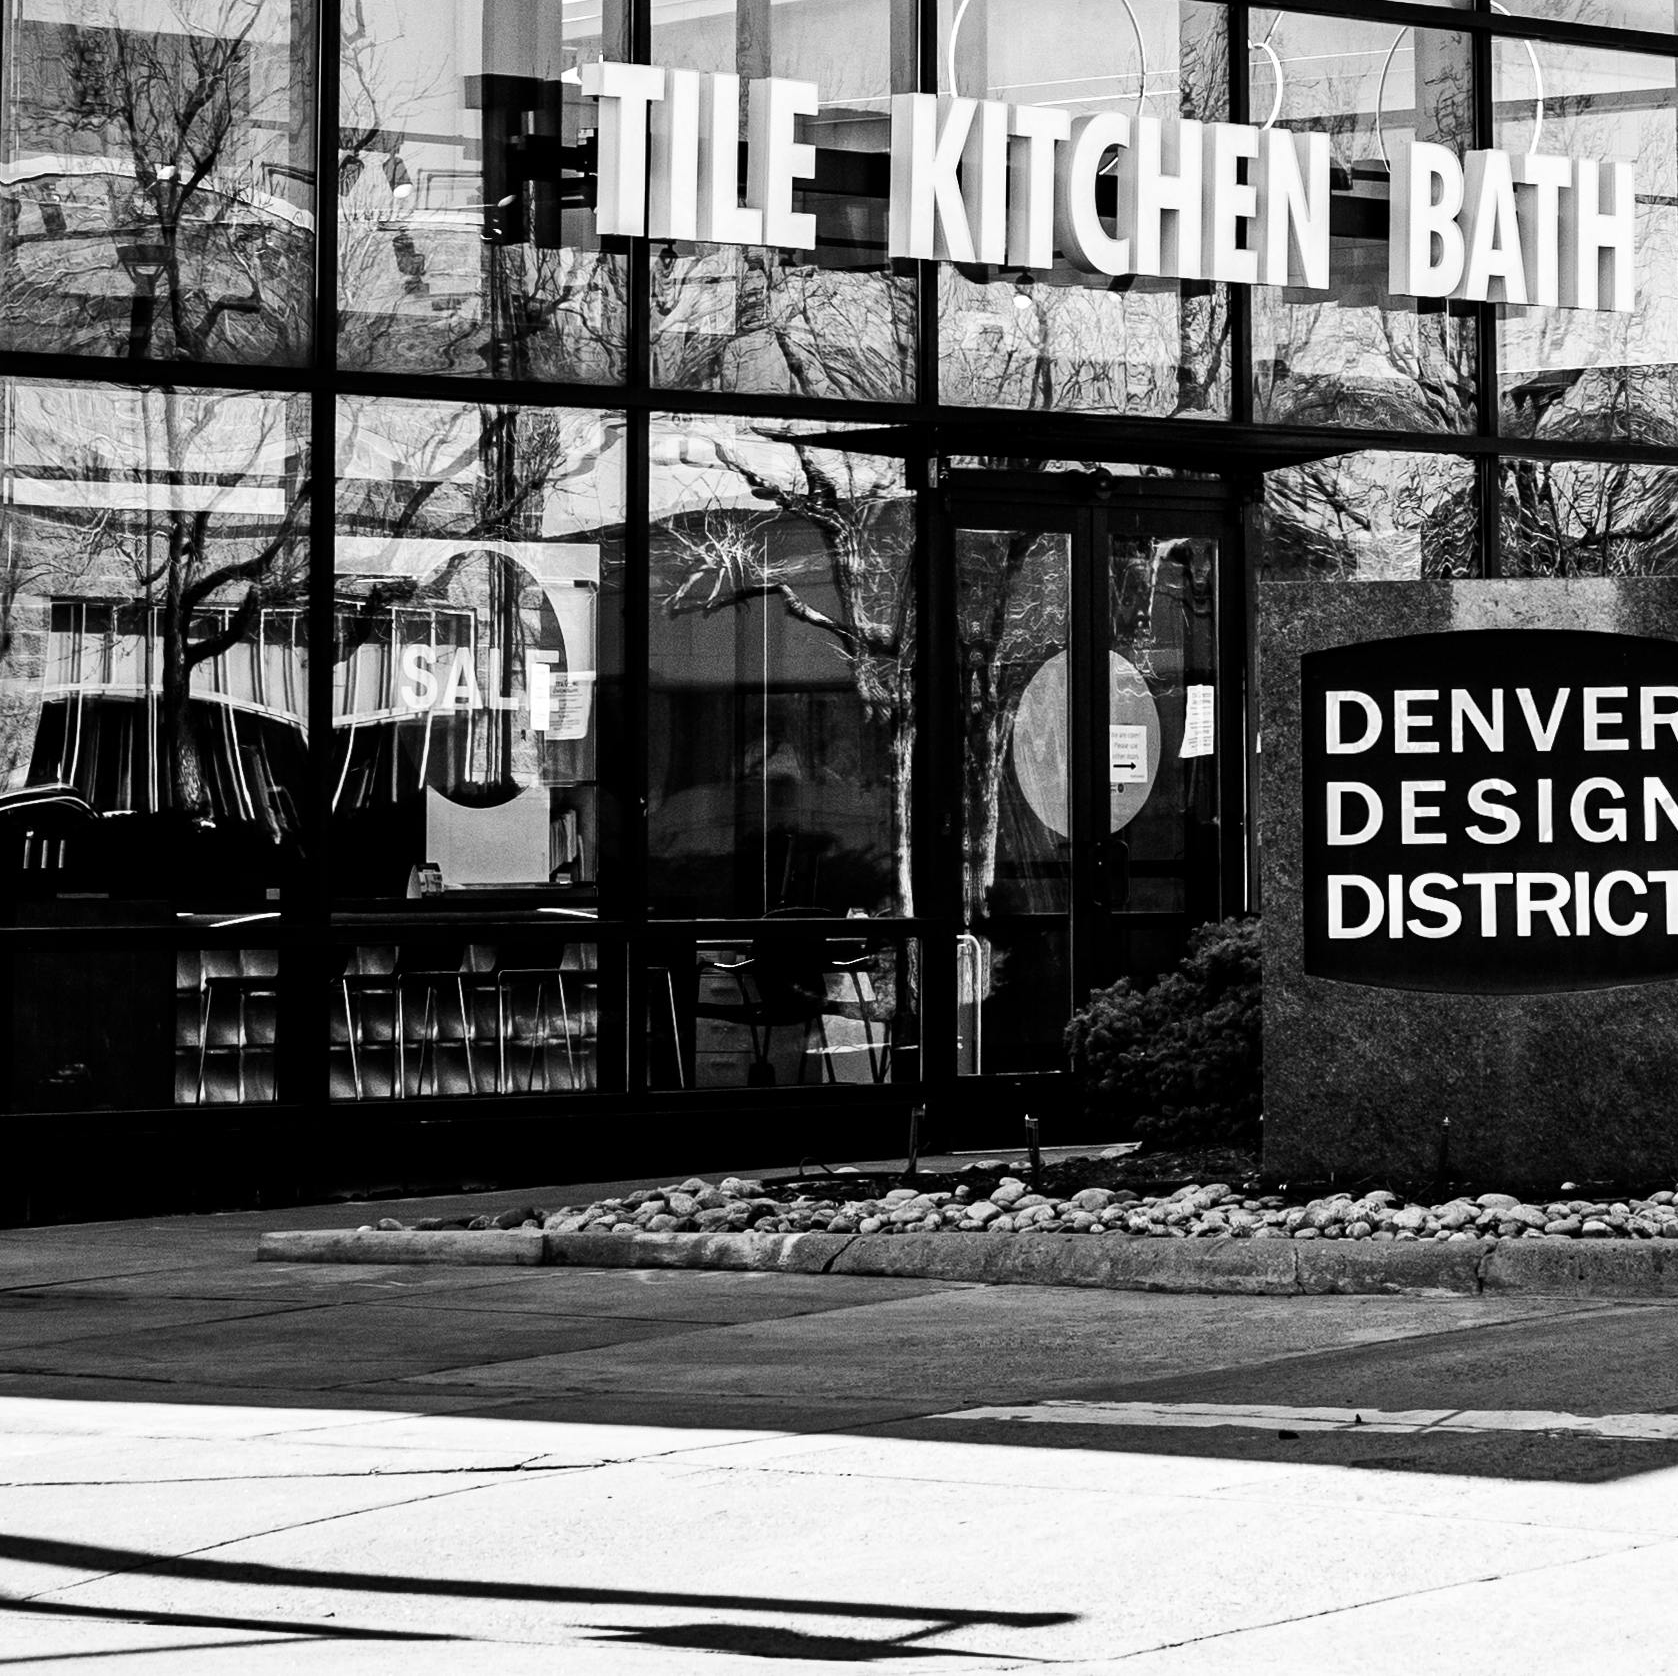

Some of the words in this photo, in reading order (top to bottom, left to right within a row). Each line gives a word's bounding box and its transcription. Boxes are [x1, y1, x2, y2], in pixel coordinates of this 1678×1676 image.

[581, 61, 818, 250] TILE
[890, 92, 1330, 290] KITCHEN
[1390, 139, 1635, 313] BATH
[401, 644, 560, 711] SALE
